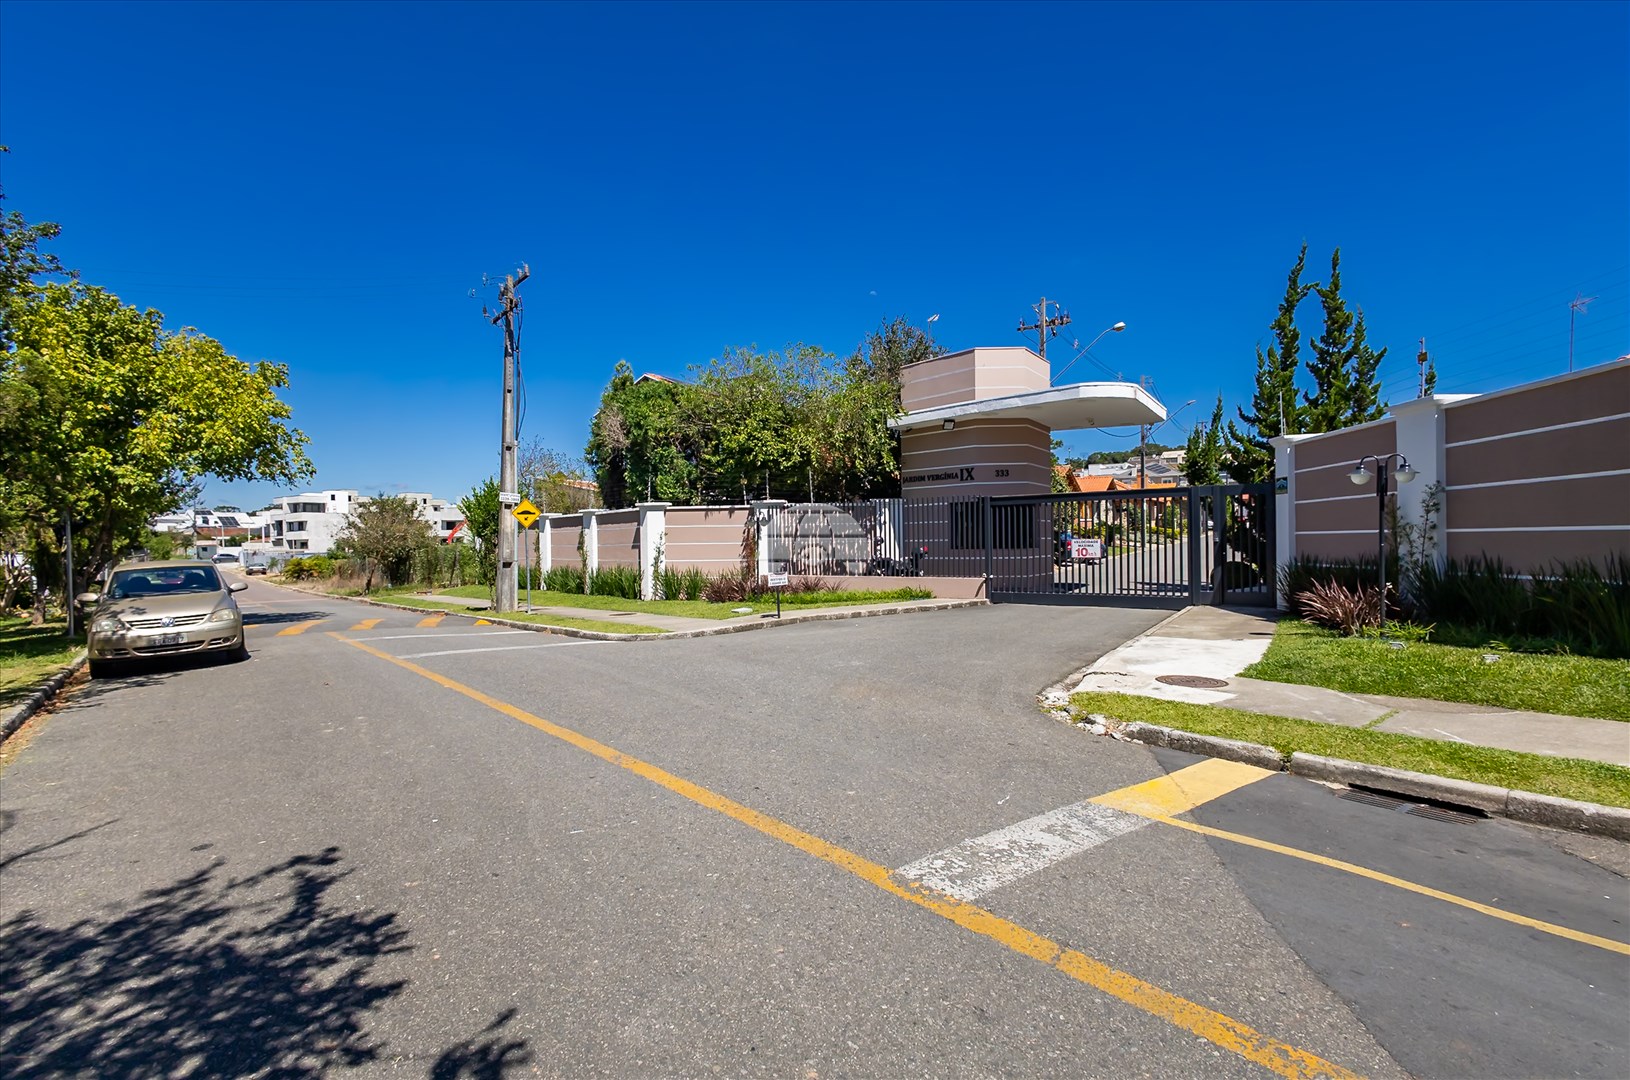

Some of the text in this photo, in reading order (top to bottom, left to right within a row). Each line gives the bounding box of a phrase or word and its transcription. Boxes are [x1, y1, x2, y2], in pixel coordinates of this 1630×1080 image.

[960, 467, 975, 481] IX
[995, 469, 1009, 477] 333
[1075, 547, 1088, 557] 10
